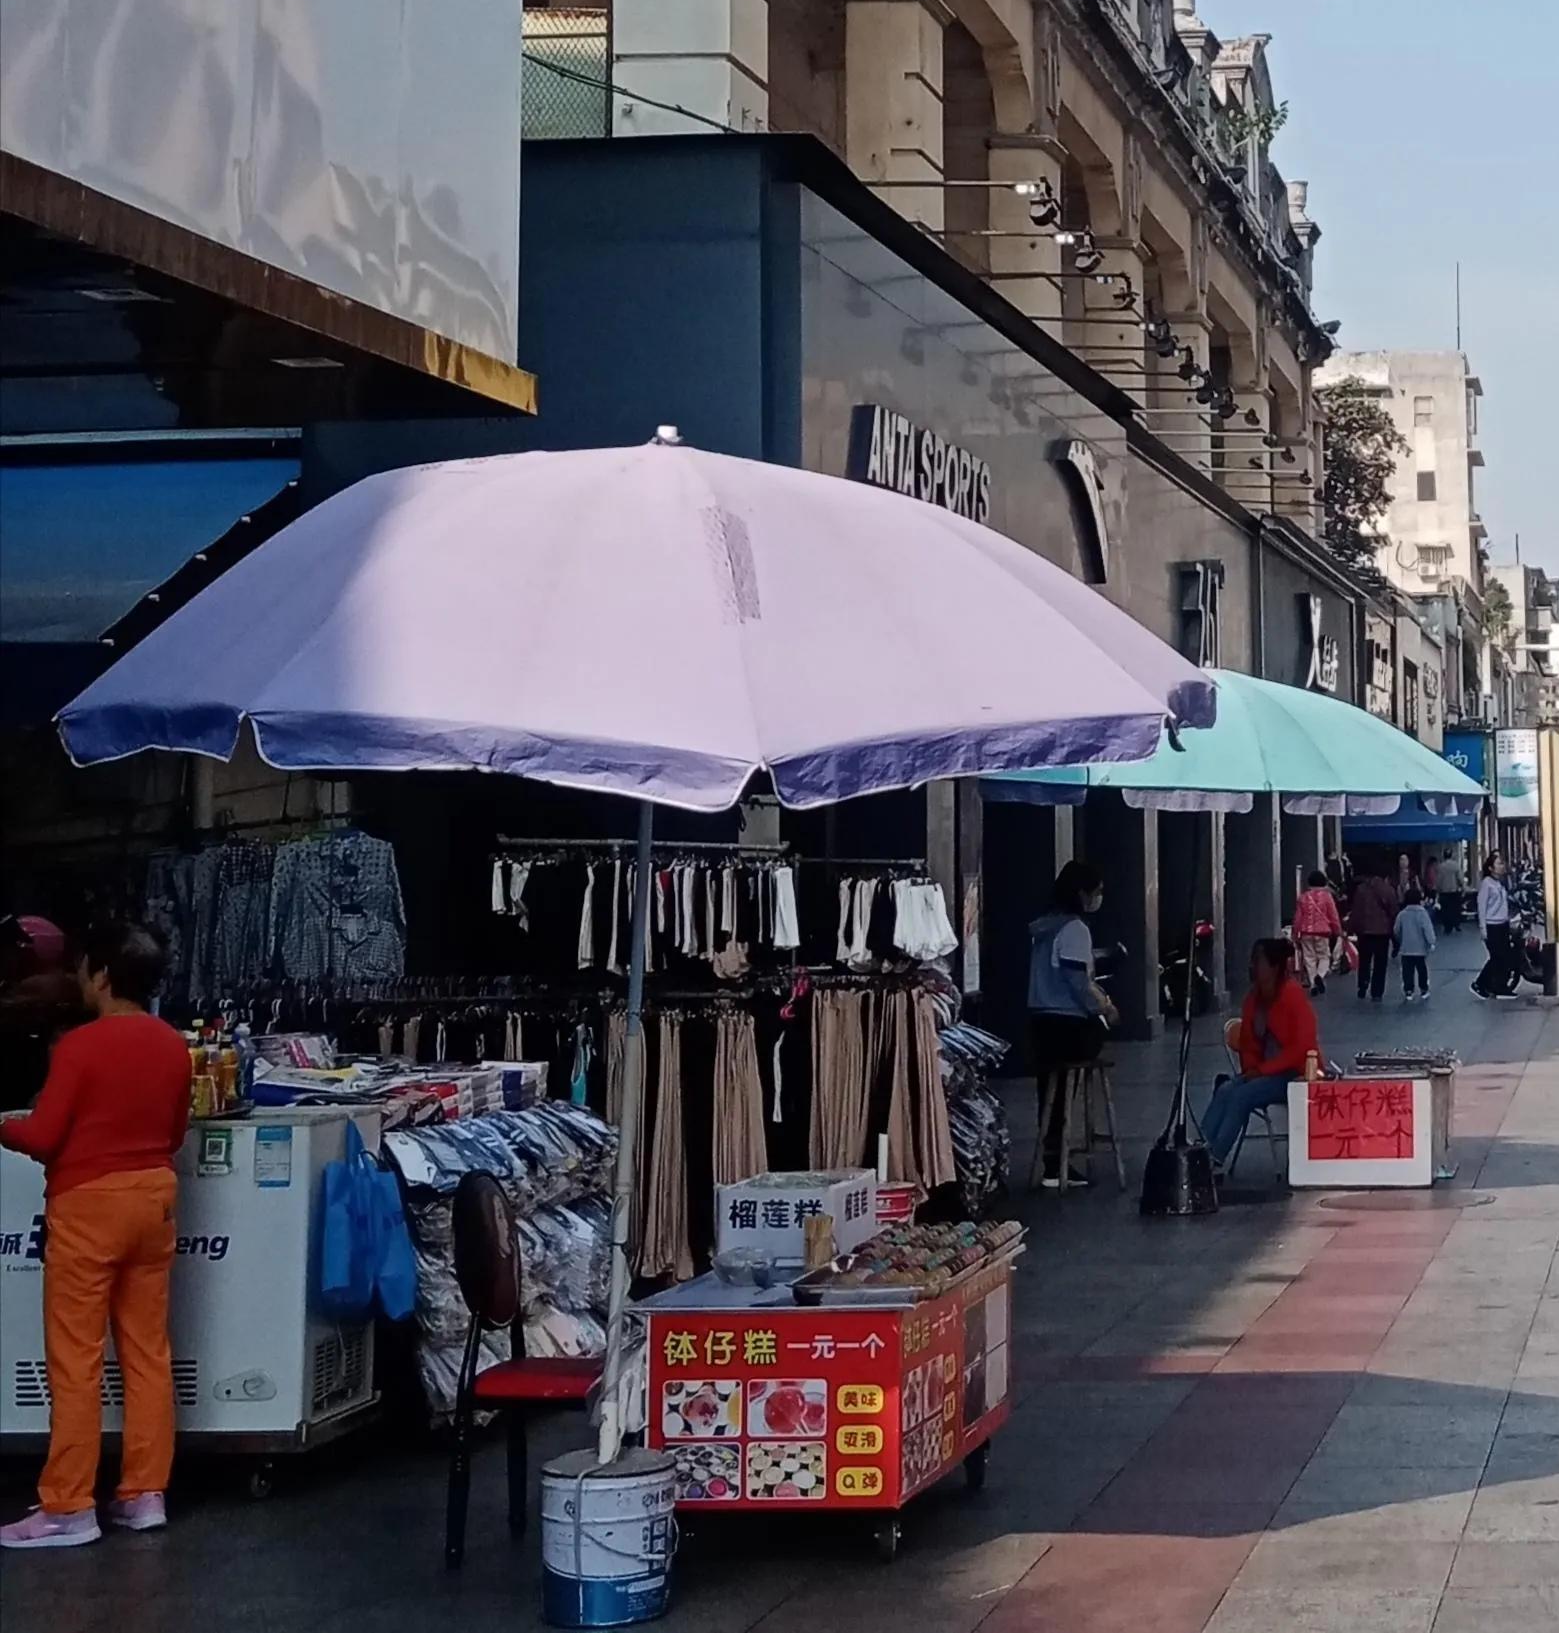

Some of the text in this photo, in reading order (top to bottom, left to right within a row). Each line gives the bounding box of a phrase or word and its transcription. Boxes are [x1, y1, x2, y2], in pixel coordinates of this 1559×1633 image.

[867, 405, 991, 526] ANTA SPORTS
[1311, 1084, 1412, 1120] 钵仔糕
[1310, 1120, 1412, 1159] 一元一个
[663, 1329, 885, 1366] 钵仔糕 一元一个
[844, 1391, 878, 1408] 美味
[844, 1431, 877, 1448] 爽滑
